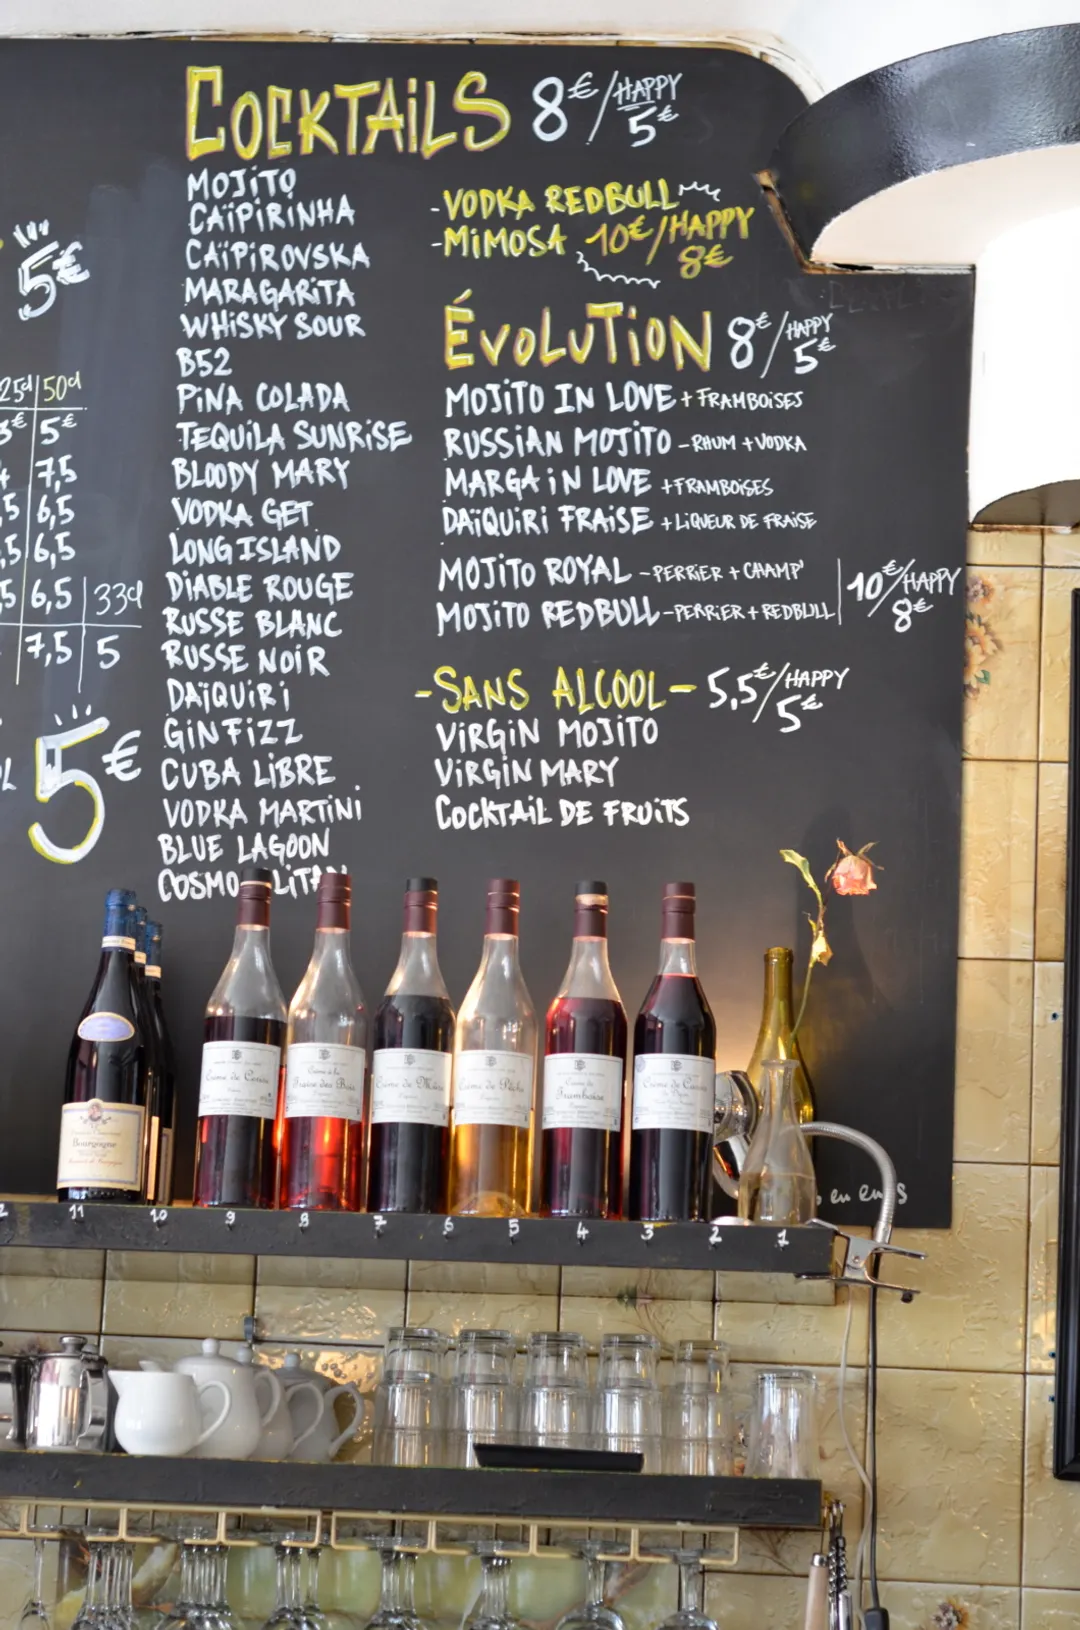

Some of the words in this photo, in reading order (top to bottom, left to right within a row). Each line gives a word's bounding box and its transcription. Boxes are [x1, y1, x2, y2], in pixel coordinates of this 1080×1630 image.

[627, 104, 680, 148] 5€
[544, 178, 680, 216] REDBULL
[678, 243, 733, 279] 8€
[17, 241, 90, 321] 5€
[293, 311, 367, 341] SOUR
[175, 346, 233, 378] B52
[793, 336, 837, 375] 5€
[255, 381, 351, 413] COLADA
[553, 382, 595, 415] IN
[605, 380, 677, 413] LOVE
[40, 413, 78, 446] 5€
[35, 453, 77, 493] 7,5
[170, 456, 260, 496] BLOODY
[270, 456, 351, 491] MARY
[444, 464, 541, 502] MARGA
[591, 465, 653, 498] LOVE
[36, 494, 76, 530] 6,5
[170, 496, 255, 529] VODKA
[260, 497, 315, 532] GET
[738, 513, 760, 530] DE
[33, 531, 76, 570] 6,5
[168, 531, 234, 568] LONG
[235, 533, 342, 566] ISLAND
[542, 553, 633, 587] ROYAL
[31, 577, 72, 614] 6,5
[262, 571, 355, 606] ROUGE
[161, 605, 245, 639] RUSSE
[254, 608, 343, 641] BLANC
[540, 595, 661, 631] REDBULL
[760, 601, 836, 621] REDBULL
[891, 597, 934, 634] 8€
[25, 630, 73, 667] 7,5
[97, 634, 121, 670] 5
[159, 638, 250, 675] RUSSE
[775, 692, 824, 734] 5€
[160, 756, 242, 792] CUBA
[539, 755, 620, 788] MARY
[27, 716, 142, 865] 5€
[162, 797, 249, 831] VODKA
[558, 798, 594, 827] DE
[156, 832, 224, 866] BLUE
[236, 826, 331, 867] LAGOON
[69, 1204, 84, 1220] 11
[225, 1211, 236, 1224] 9
[508, 1219, 520, 1234] 5
[576, 1222, 589, 1239] 4
[641, 1224, 654, 1240] 3
[709, 1226, 722, 1242] 2
